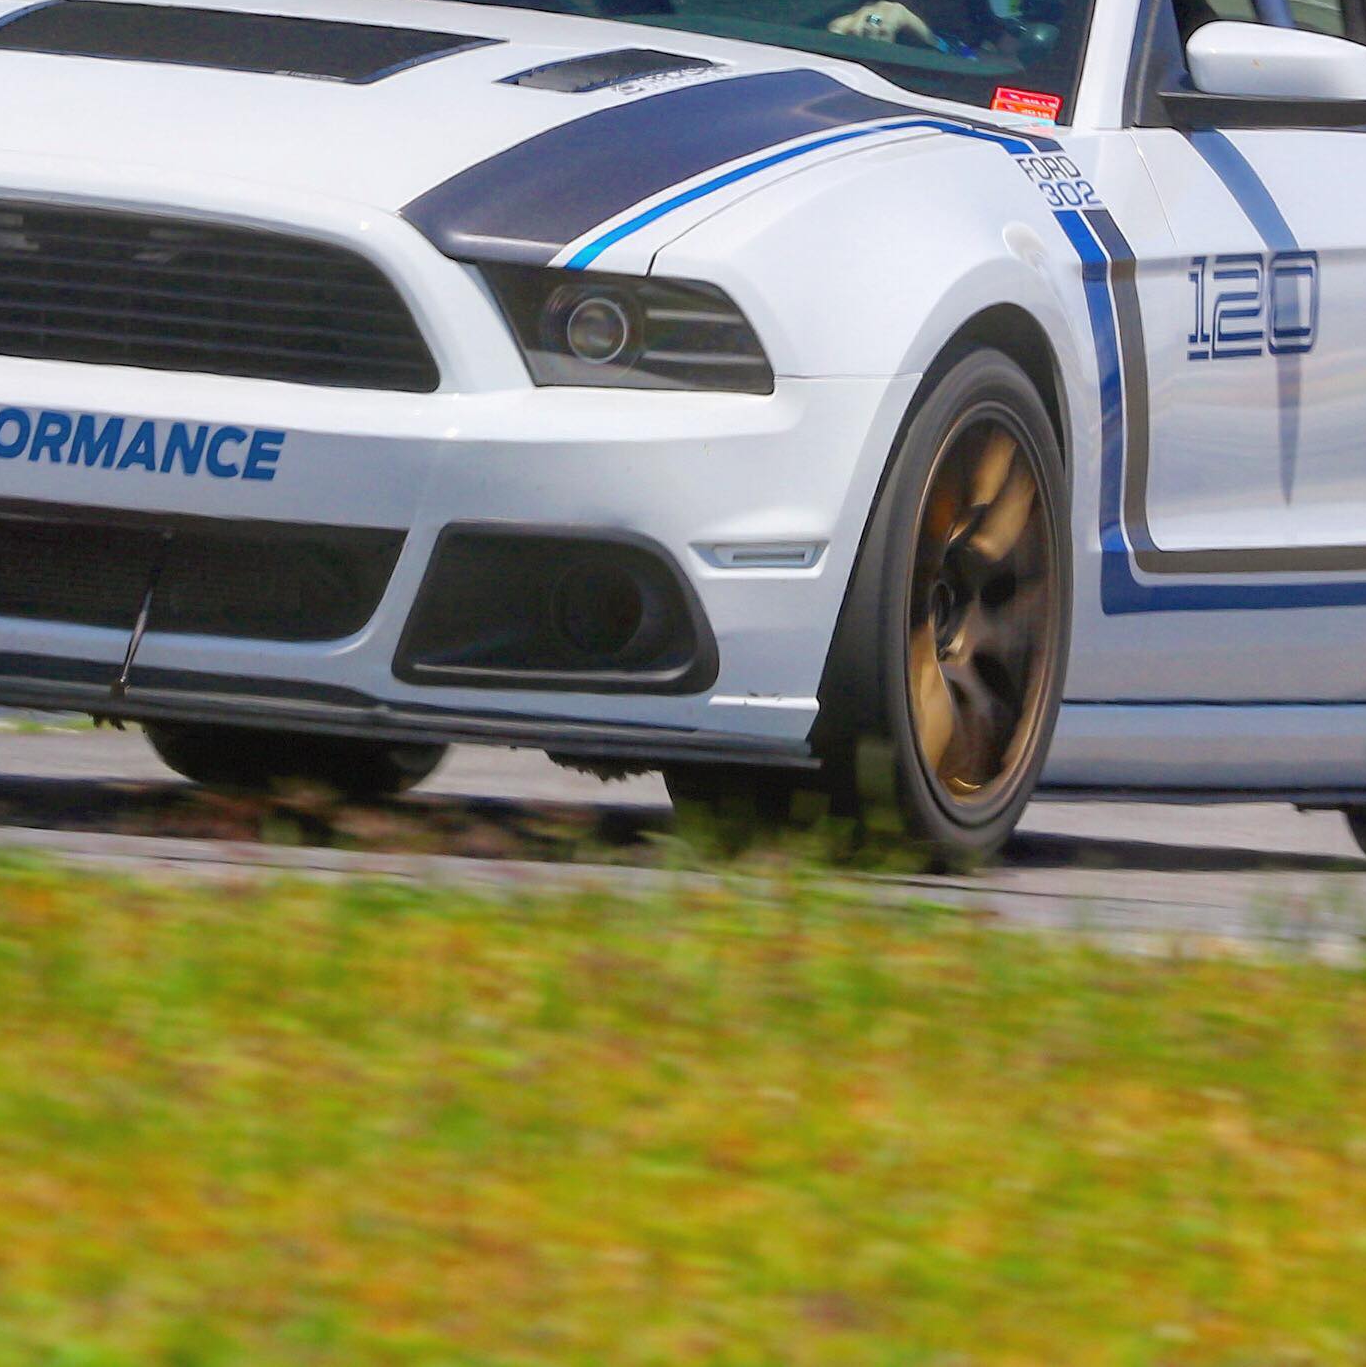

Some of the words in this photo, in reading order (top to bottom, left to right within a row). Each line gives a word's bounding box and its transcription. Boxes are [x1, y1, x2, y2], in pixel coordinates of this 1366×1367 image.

[1015, 154, 1082, 183] FORD
[1038, 179, 1104, 208] 302
[1187, 249, 1321, 362] 120
